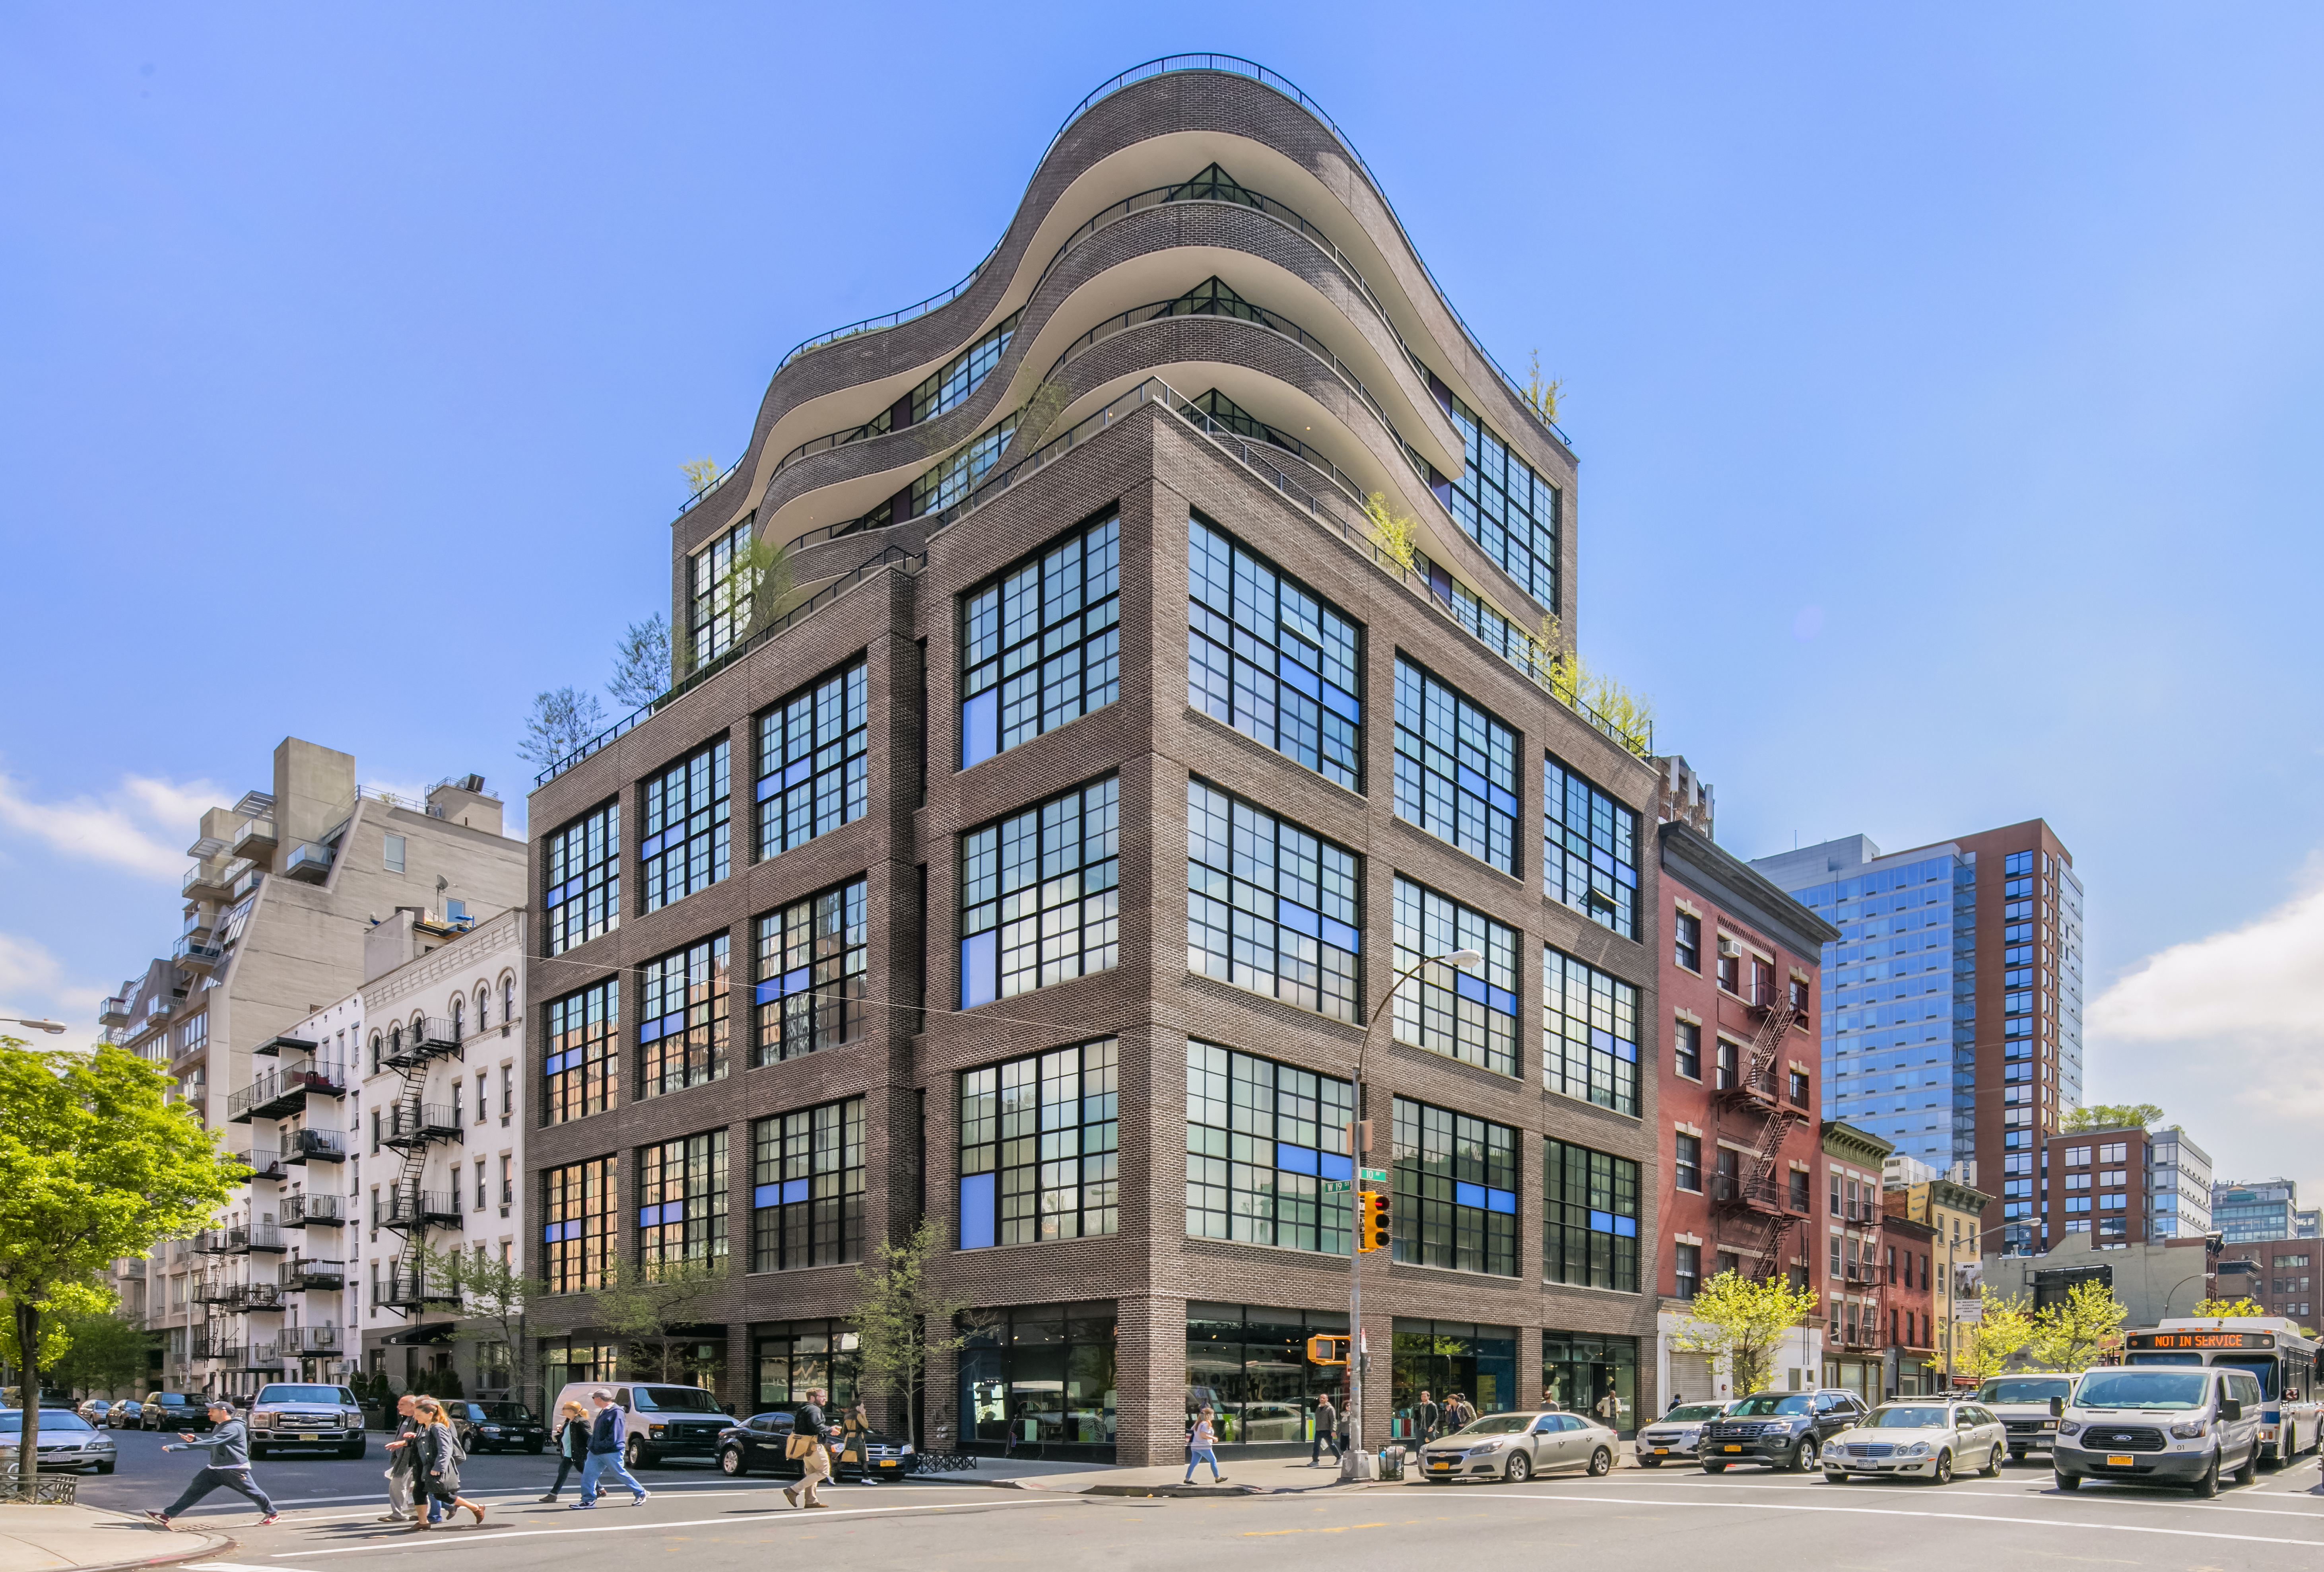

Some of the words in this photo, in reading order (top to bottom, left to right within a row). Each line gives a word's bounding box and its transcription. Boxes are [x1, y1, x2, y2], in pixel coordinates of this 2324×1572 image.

[1676, 1044, 1691, 1055] SHAFTWAY
[1676, 1158, 1692, 1167] SHAFTWAY
[1366, 1170, 1373, 1179] 10
[1327, 1183, 1333, 1192] W
[1336, 1182, 1342, 1191] 19
[2155, 1336, 2175, 1347] NOT
[2179, 1336, 2191, 1347] IN
[2194, 1334, 2242, 1347] SERVICE
